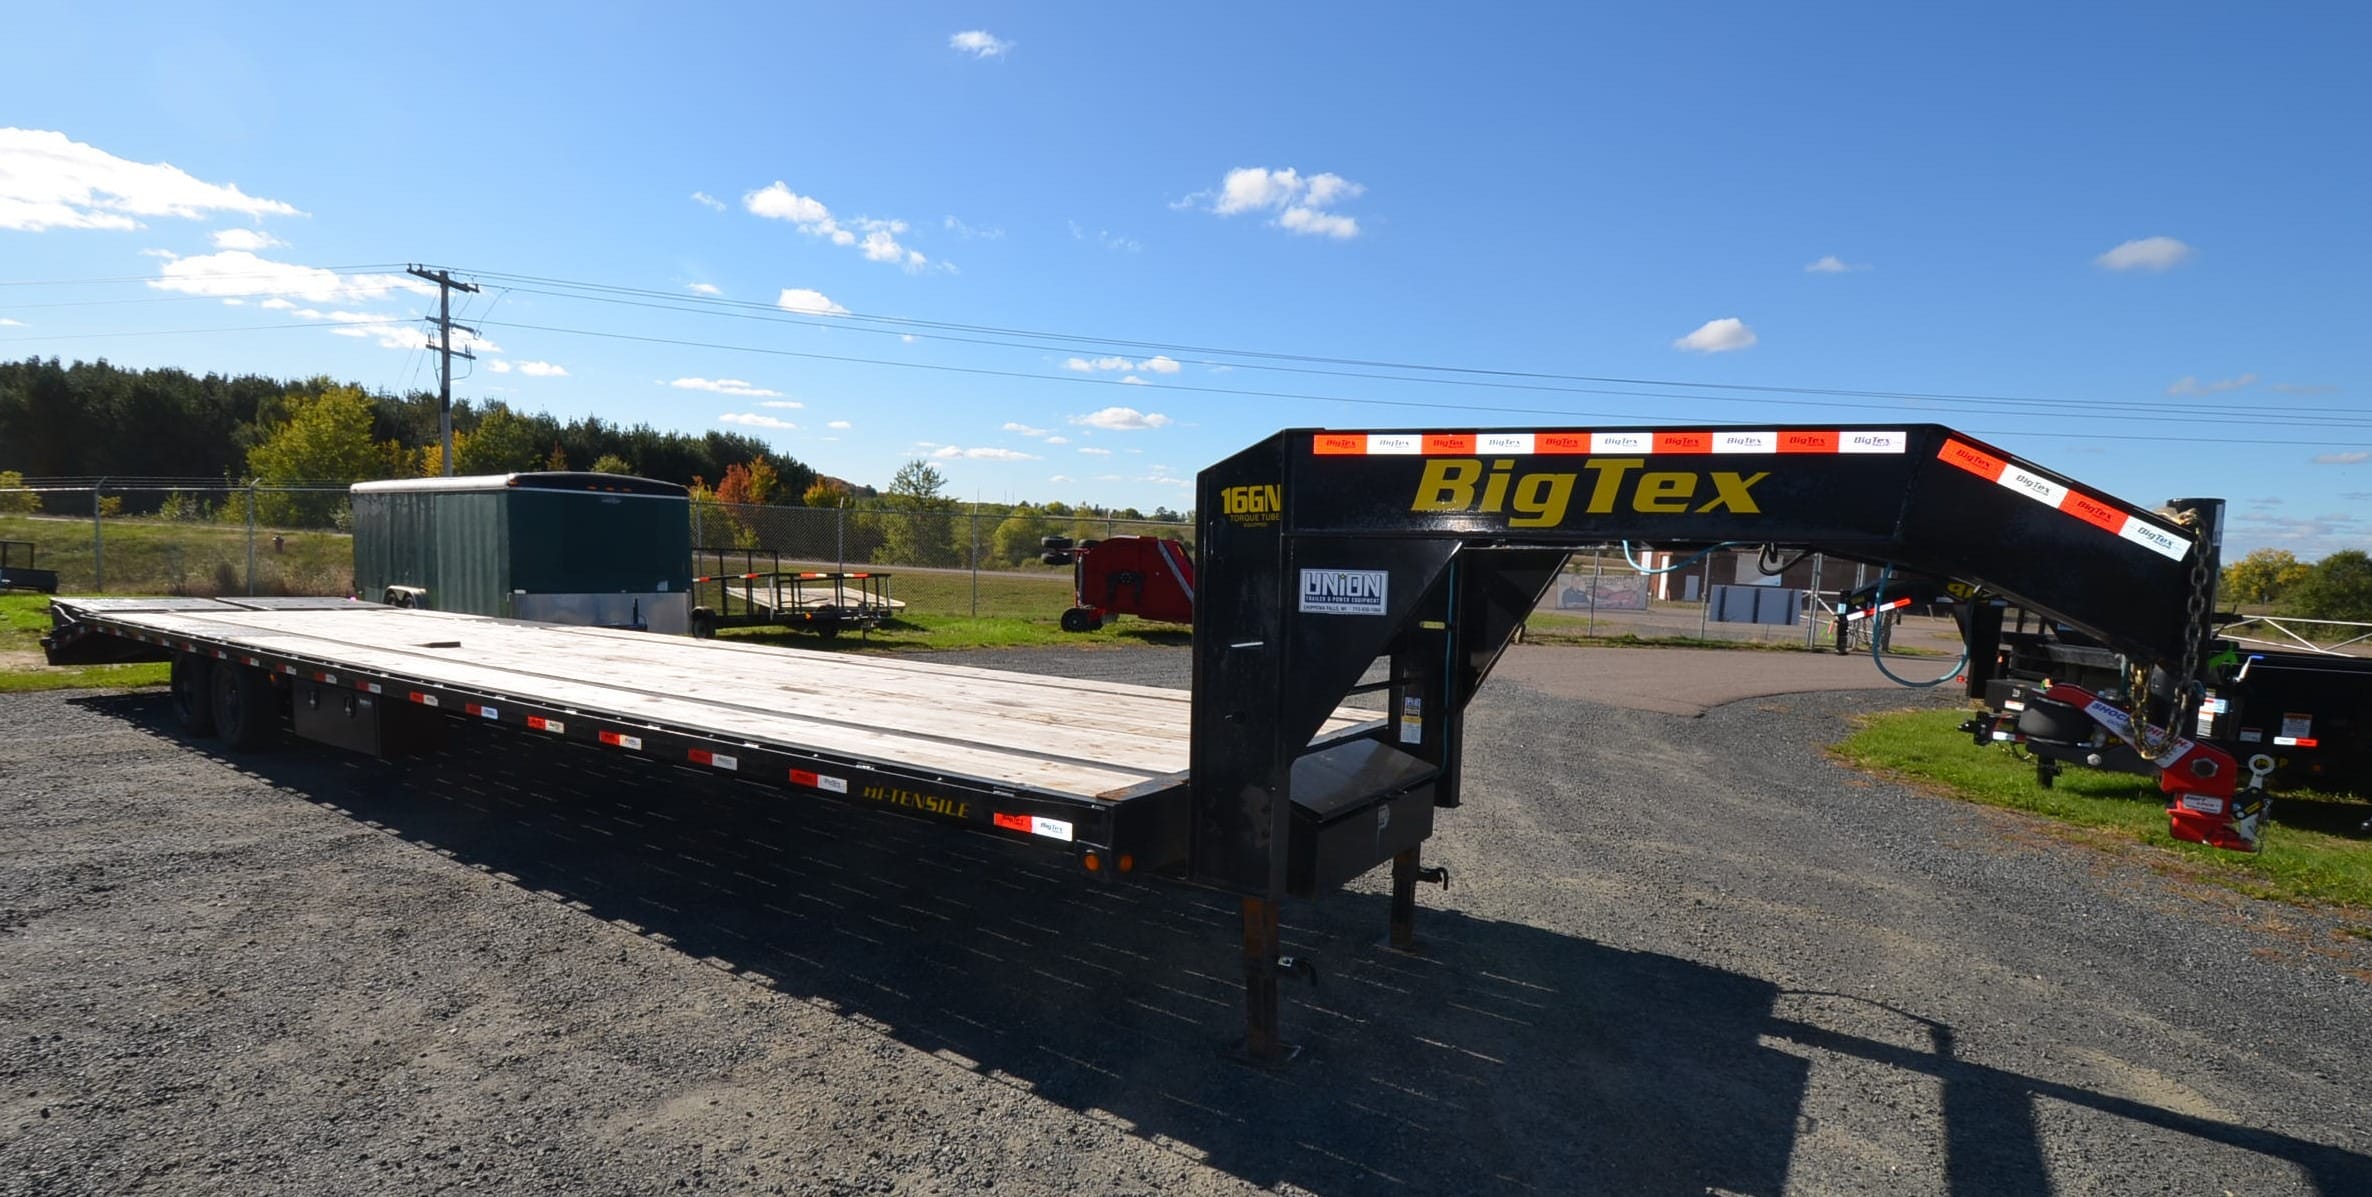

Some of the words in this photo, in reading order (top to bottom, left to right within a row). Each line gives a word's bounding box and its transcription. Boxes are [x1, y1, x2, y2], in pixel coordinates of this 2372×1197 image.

[1726, 437, 1762, 446] BigTex
[1789, 436, 1825, 445] BigTex
[1854, 436, 1890, 445] BigTex
[1956, 449, 1990, 468] BigTex
[1411, 458, 1771, 528] BigTex
[2016, 474, 2050, 494] BigTex
[1221, 484, 1280, 514] 16GN
[1230, 513, 1260, 522] TORQUE
[1260, 512, 1280, 521] TUBE
[2077, 500, 2111, 520] BigTex
[2137, 527, 2172, 547] BigTex
[863, 786, 970, 818] HI-TENSILE
